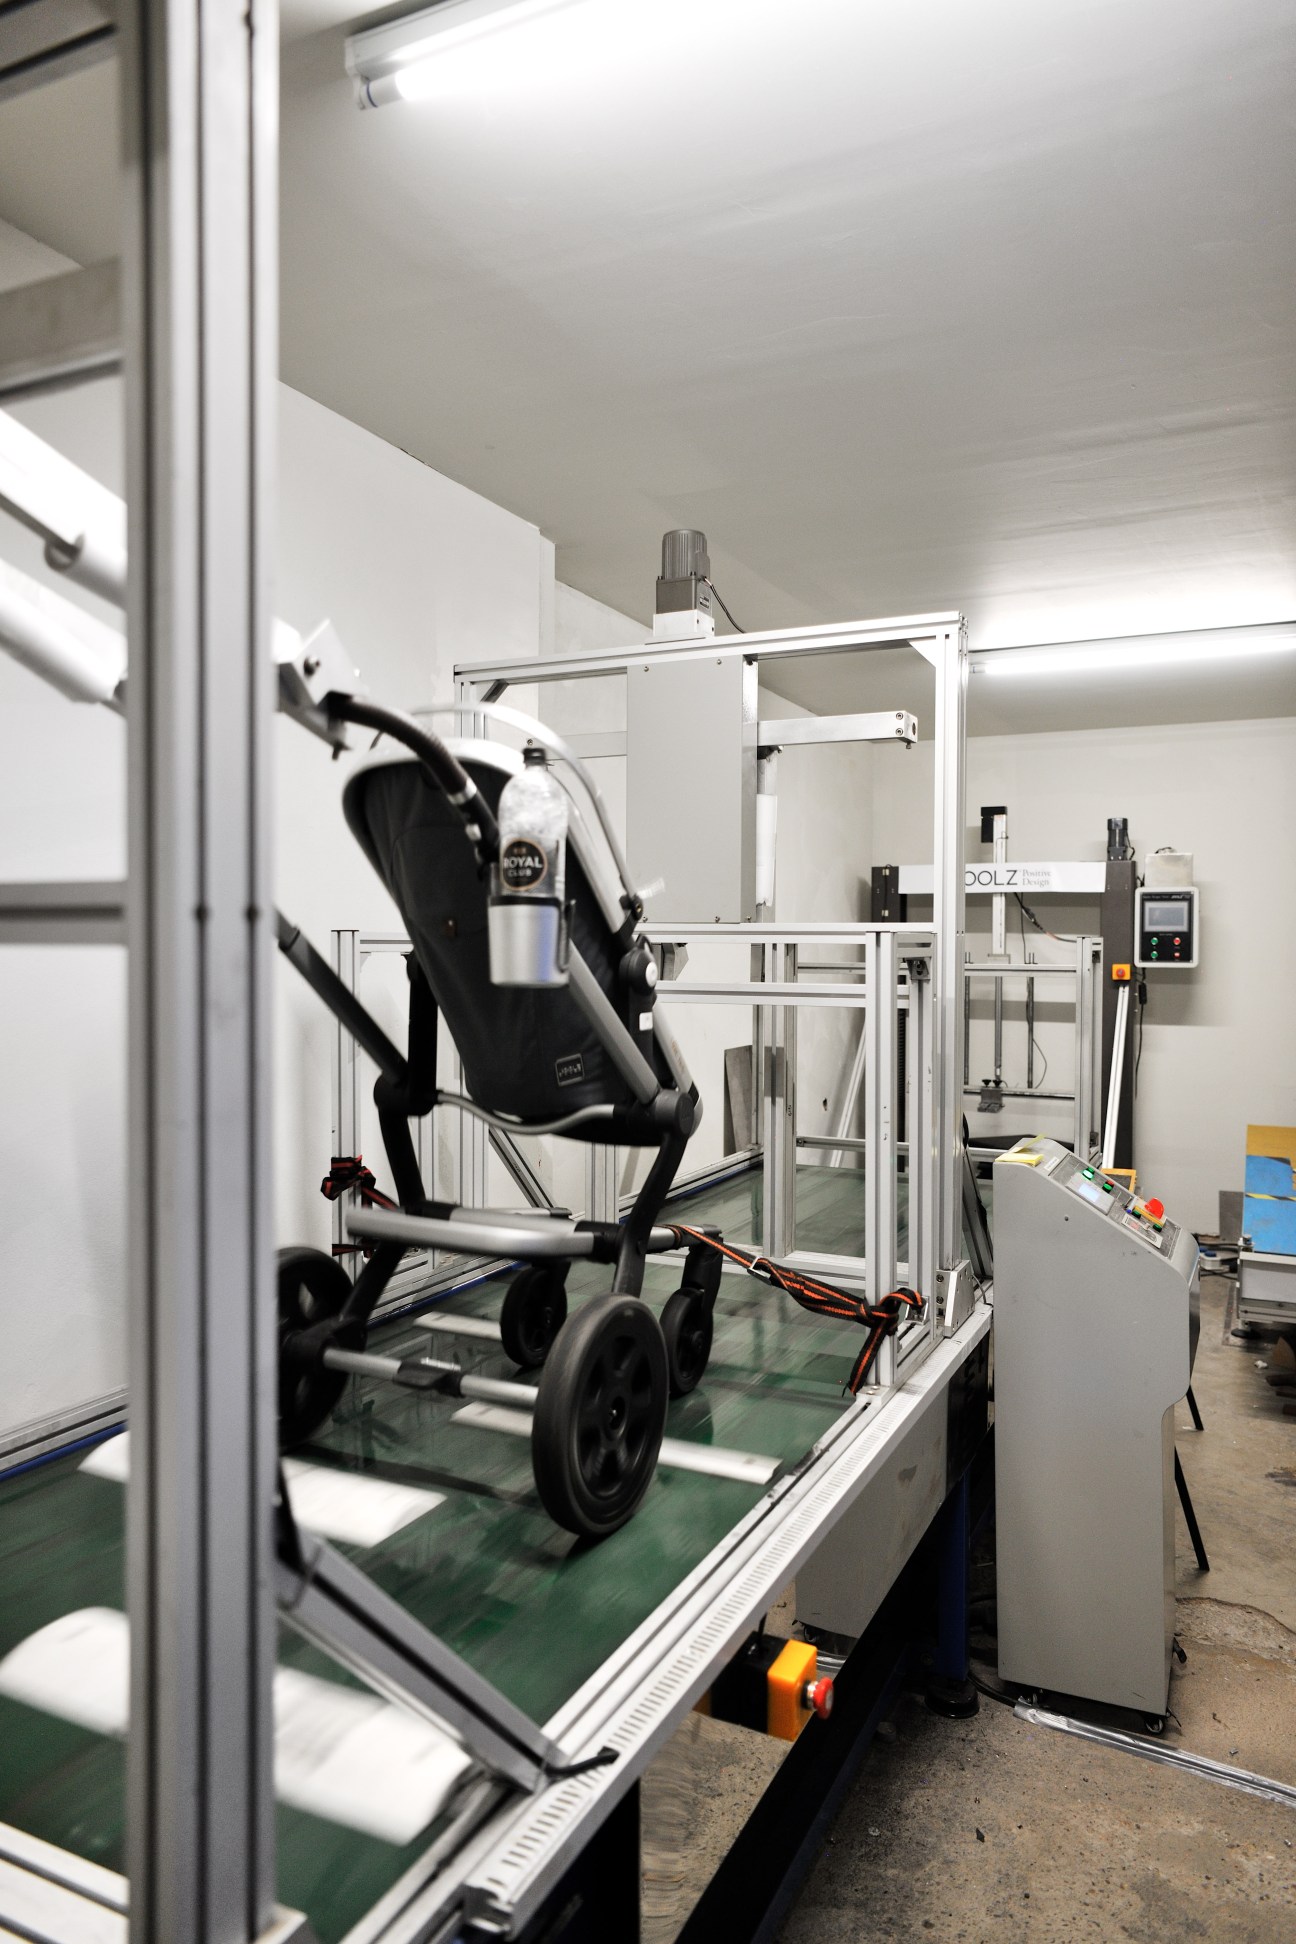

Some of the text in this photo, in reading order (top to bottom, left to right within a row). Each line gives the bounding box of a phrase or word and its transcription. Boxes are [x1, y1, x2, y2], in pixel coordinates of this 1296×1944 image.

[503, 856, 542, 868] ROYAL
[1022, 869, 1051, 877] Positive
[1022, 878, 1050, 888] Design
